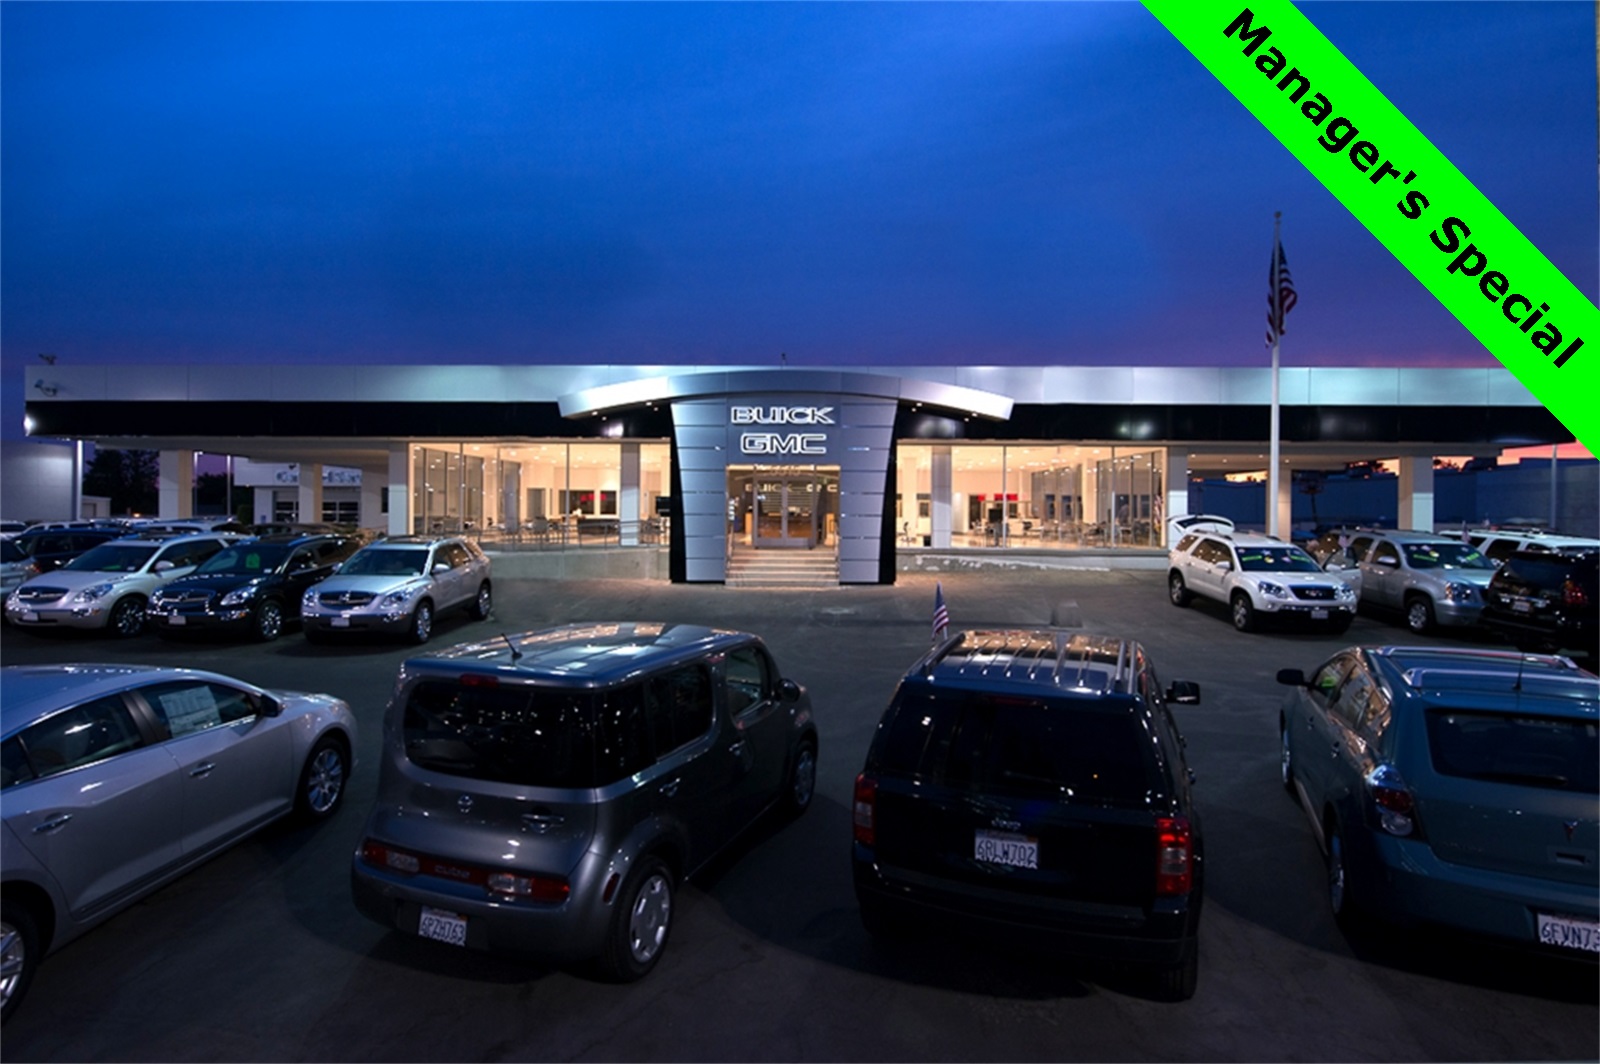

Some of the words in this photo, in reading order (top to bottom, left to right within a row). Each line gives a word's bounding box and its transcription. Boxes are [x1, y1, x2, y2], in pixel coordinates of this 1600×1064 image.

[731, 406, 835, 425] BUICK
[740, 432, 827, 454] GMC
[977, 840, 1035, 862] 6RLW702
